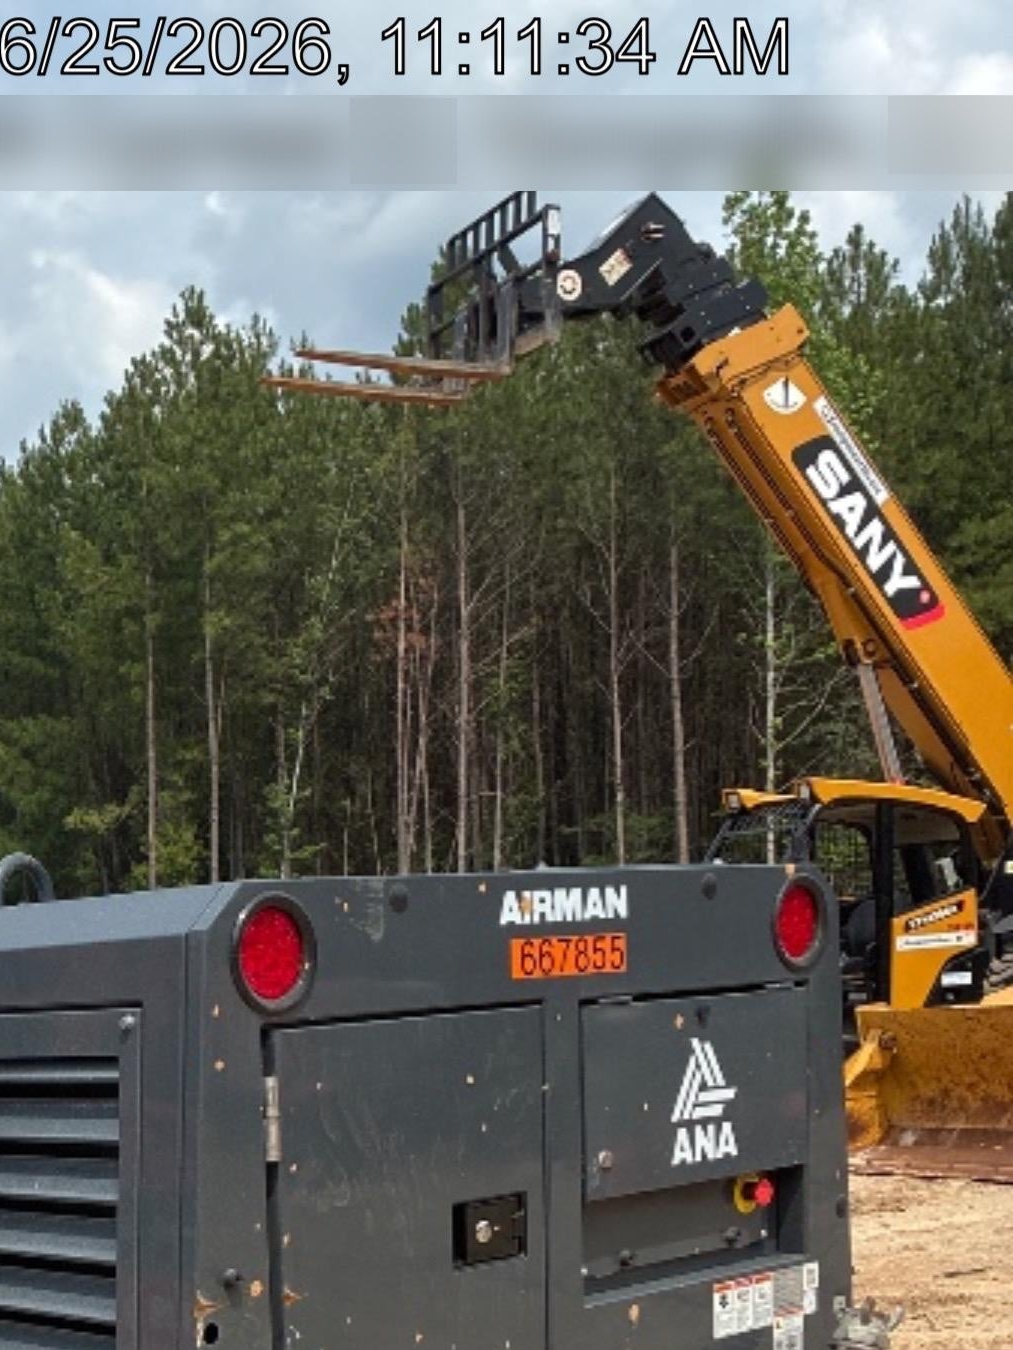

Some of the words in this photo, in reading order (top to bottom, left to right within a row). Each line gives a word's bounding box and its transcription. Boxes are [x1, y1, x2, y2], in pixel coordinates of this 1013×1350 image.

[805, 449, 922, 598] SANY
[499, 885, 627, 926] AIRMAN
[520, 935, 625, 976] 667855
[671, 1121, 738, 1166] ANA
